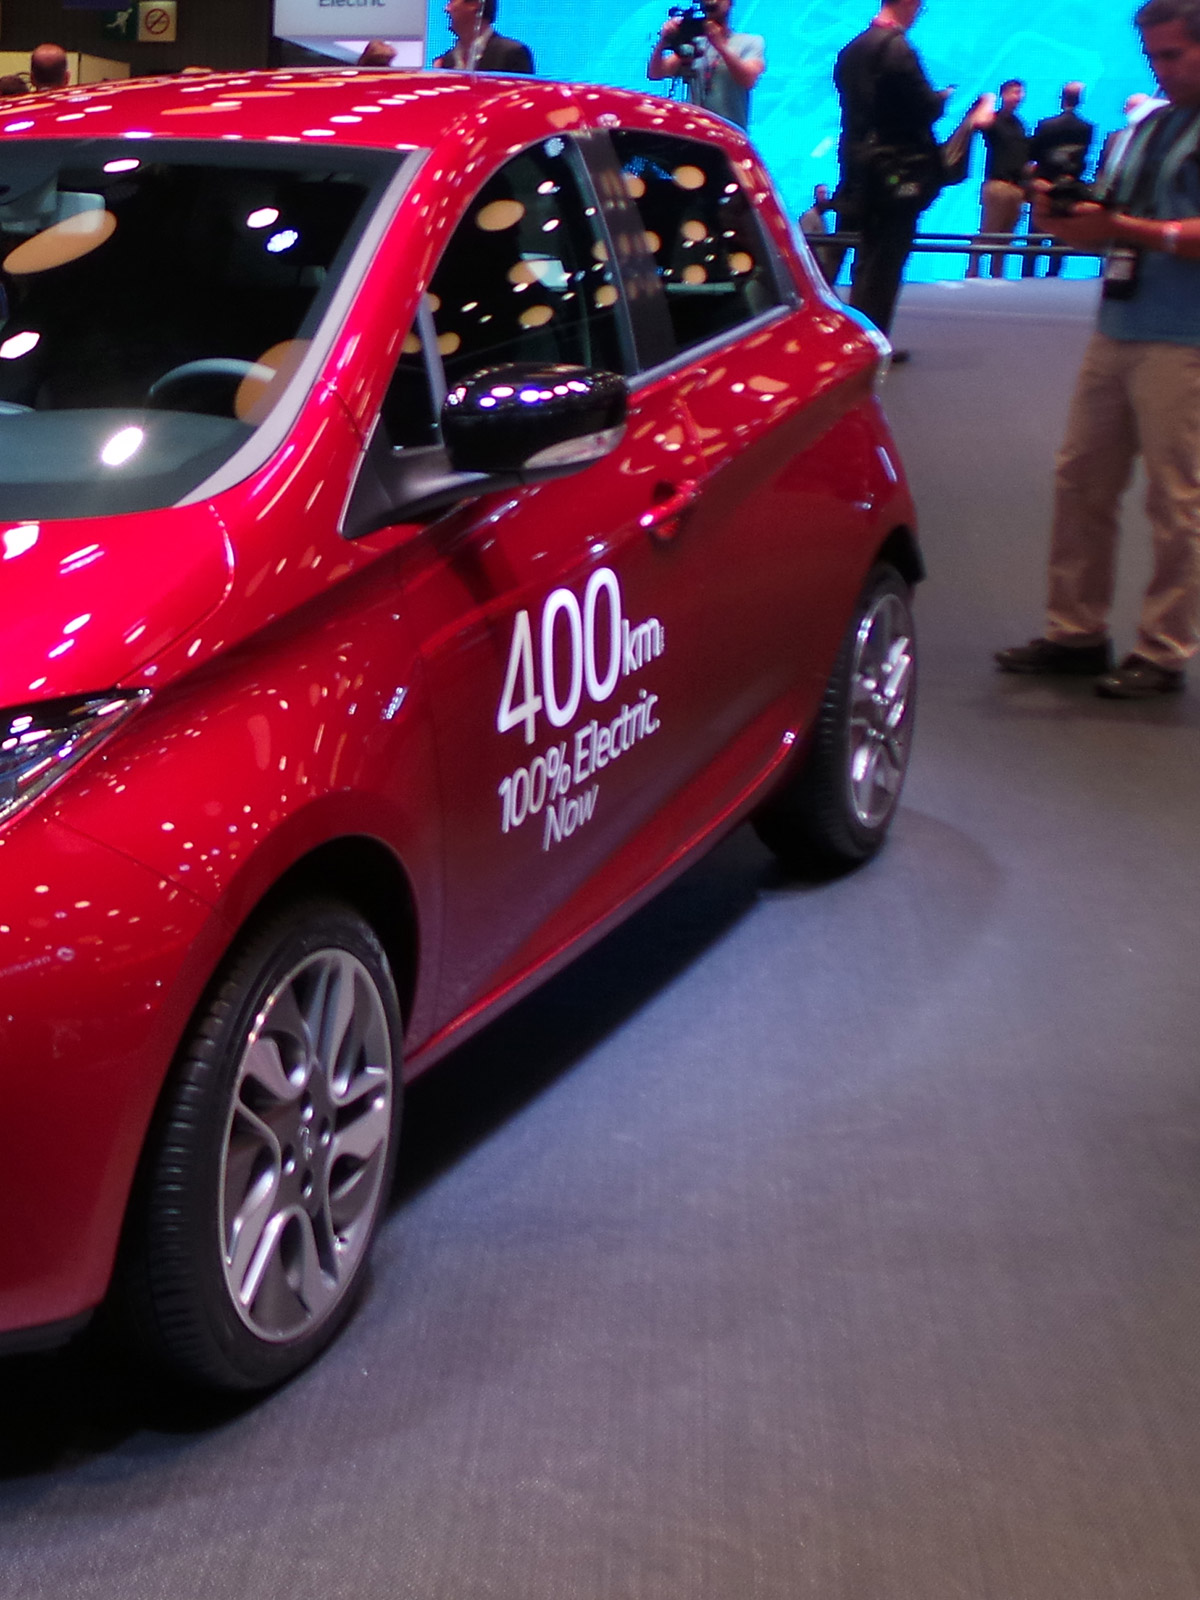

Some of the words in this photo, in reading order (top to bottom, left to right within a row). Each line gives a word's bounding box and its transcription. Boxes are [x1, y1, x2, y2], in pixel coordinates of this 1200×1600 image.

[498, 741, 571, 834] 100%
[574, 688, 661, 784] Electric.
[542, 784, 599, 852] Now
